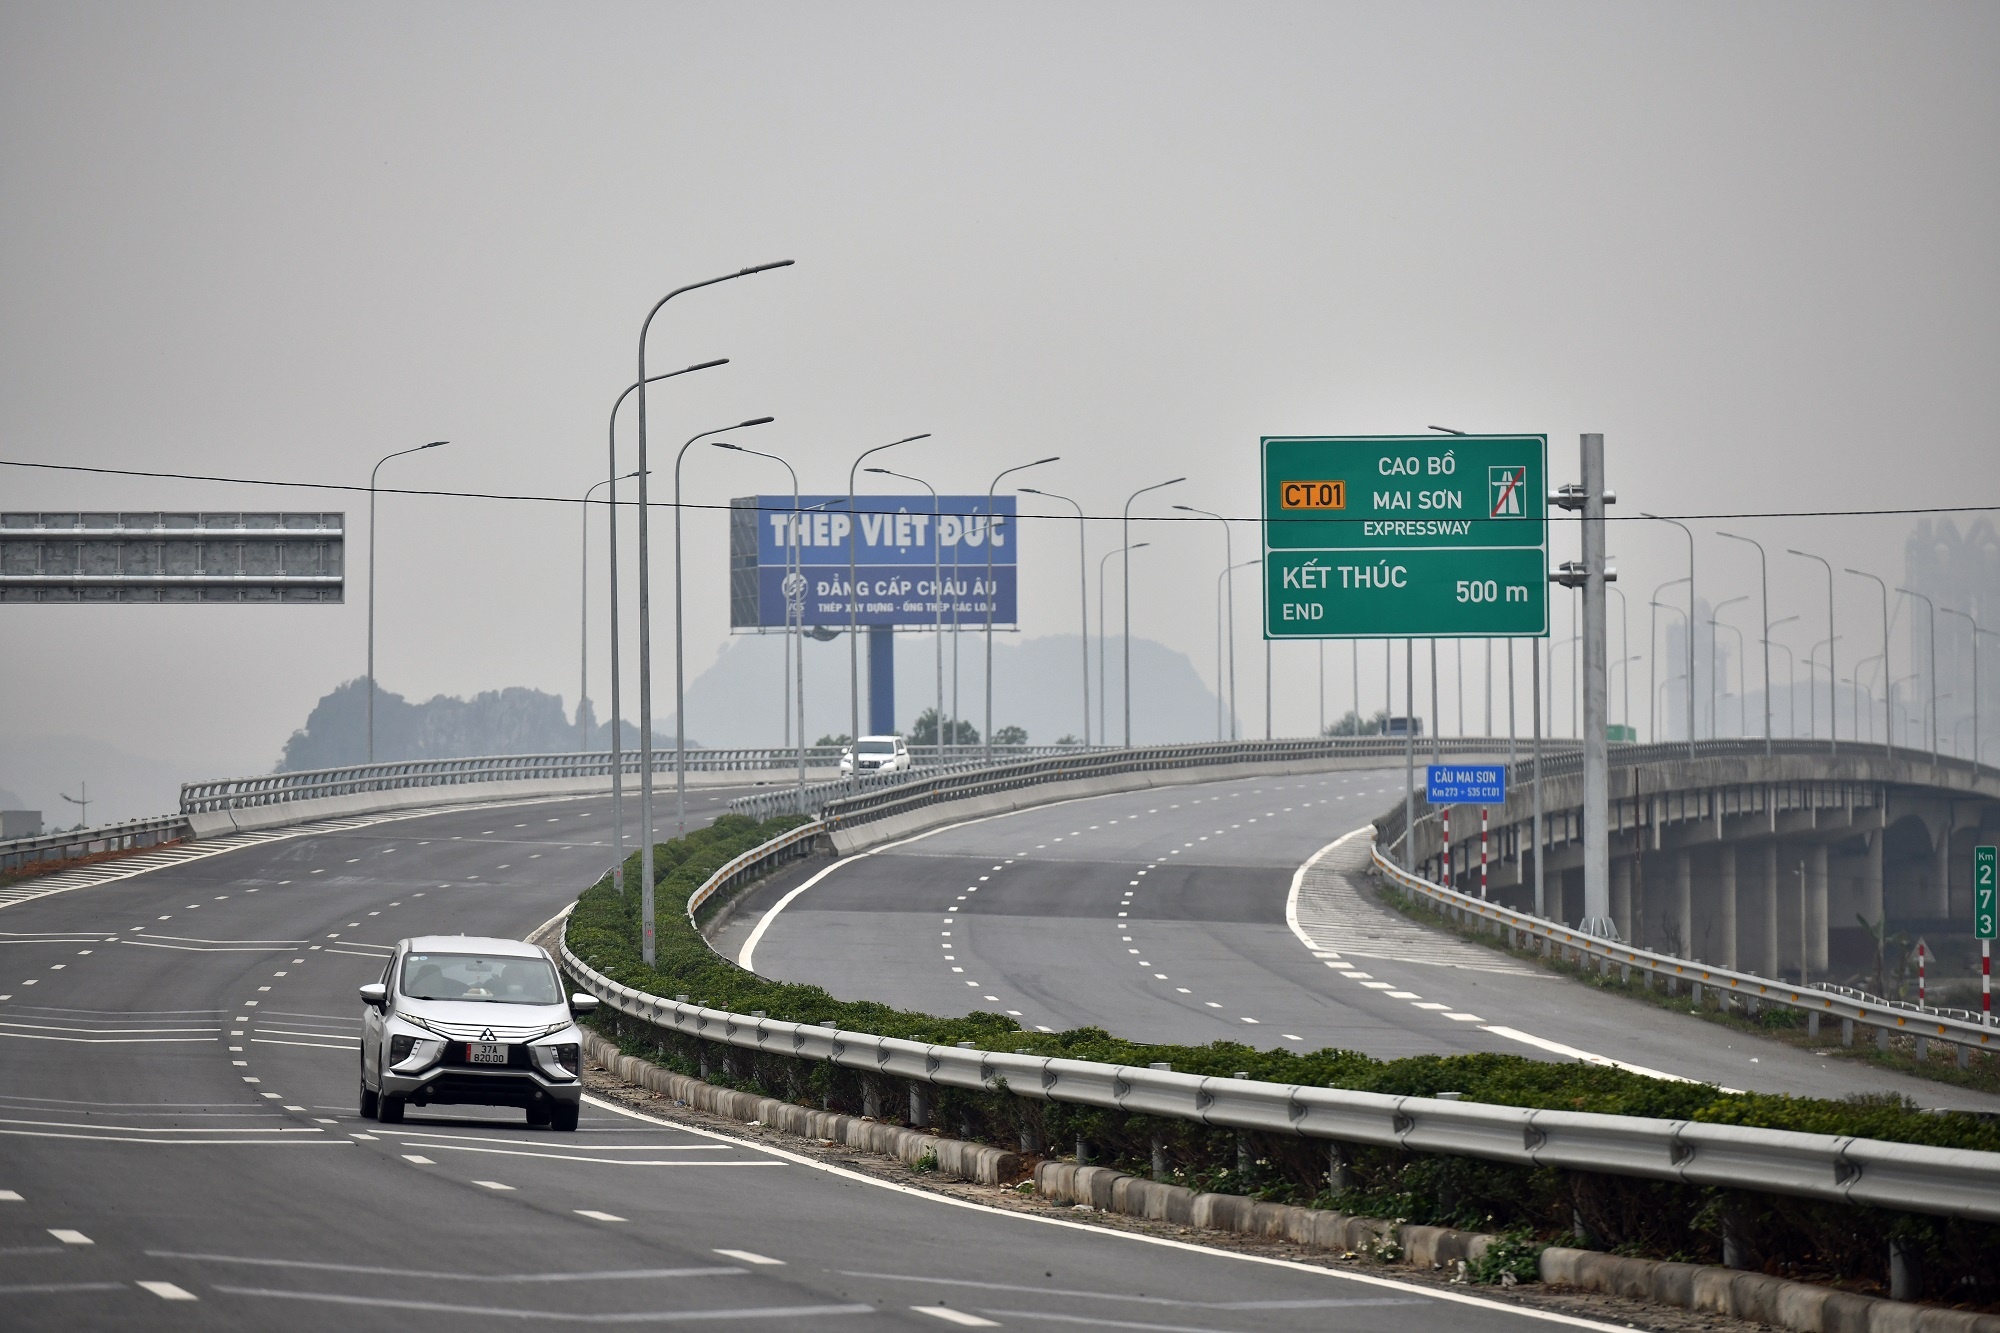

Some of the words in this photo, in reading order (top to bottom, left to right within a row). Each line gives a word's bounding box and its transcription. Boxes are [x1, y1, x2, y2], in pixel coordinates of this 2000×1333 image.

[1378, 457, 1420, 476] CAO
[1427, 449, 1455, 475] BỒ
[1285, 484, 1341, 506] CT.01
[1373, 492, 1411, 509] MAI
[1418, 489, 1462, 509] SƠN
[770, 506, 851, 546] THÉP
[859, 506, 928, 554] VIỆT
[937, 506, 1004, 547] ĐỨC
[1364, 521, 1471, 535] EXPRESSWAY
[1283, 558, 1331, 588] KẾT
[1338, 559, 1407, 588] THÚC
[875, 575, 911, 596] CẤP
[917, 577, 967, 596] CHÂU
[973, 577, 997, 596] ÂU
[1456, 580, 1497, 603] 500
[1506, 585, 1528, 602] m
[1283, 603, 1323, 620] END
[1435, 767, 1453, 783] CẦU
[1457, 771, 1473, 783] MAI
[1476, 770, 1496, 783] SƠN
[1468, 787, 1480, 797] 535
[1978, 852, 1993, 861] Km
[481, 1045, 497, 1053] 37A
[474, 1054, 504, 1063] 820.00
